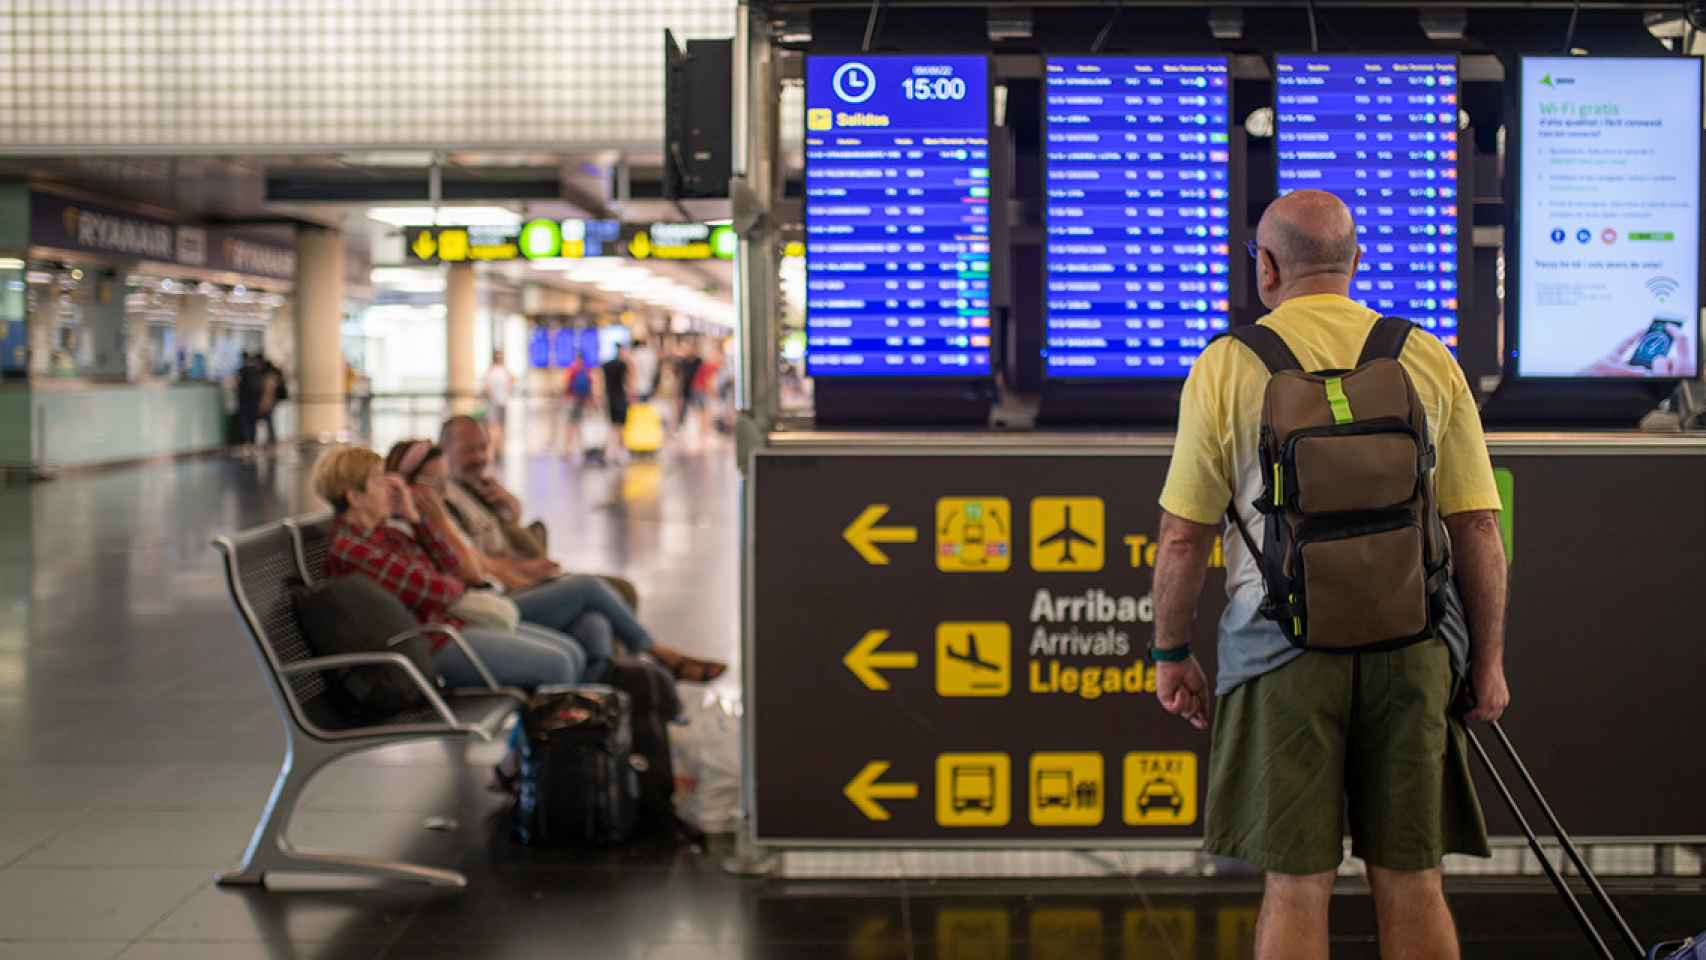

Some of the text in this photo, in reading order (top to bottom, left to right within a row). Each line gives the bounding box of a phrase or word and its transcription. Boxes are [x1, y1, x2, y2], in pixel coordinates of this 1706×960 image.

[902, 77, 966, 100] 15:00
[1578, 102, 1619, 119] gratis
[1029, 588, 1154, 622] Arribad
[1029, 626, 1130, 656] Arrivals
[1029, 660, 1158, 699] Llegada
[1139, 760, 1183, 774] TAXI
